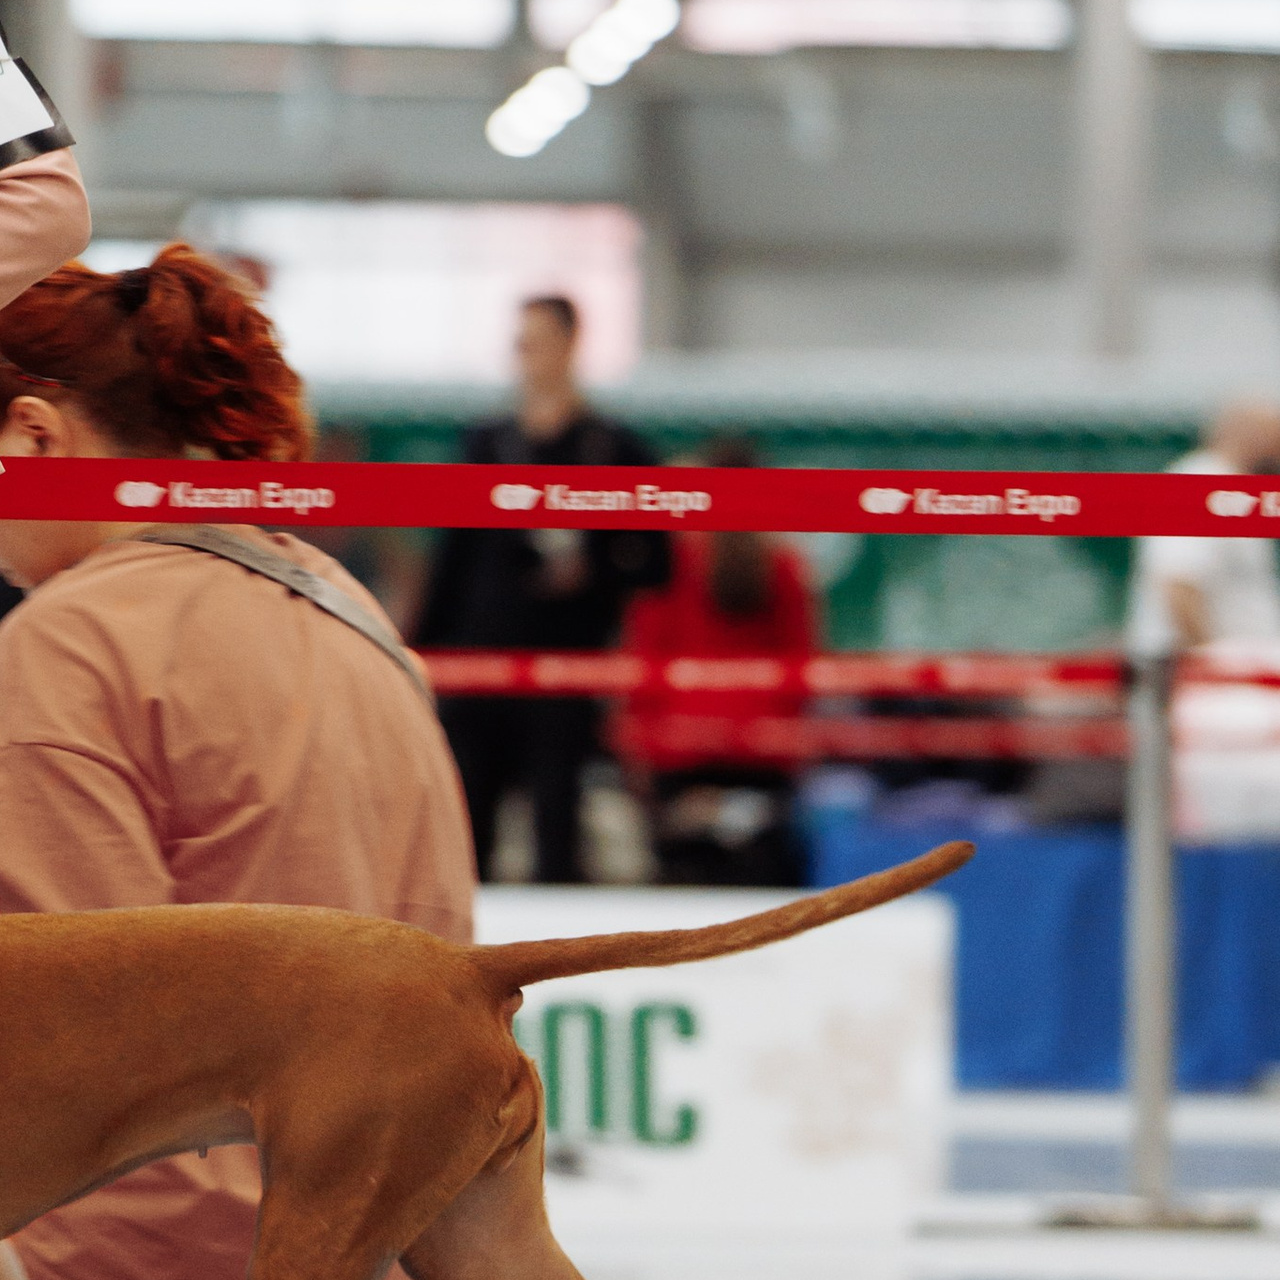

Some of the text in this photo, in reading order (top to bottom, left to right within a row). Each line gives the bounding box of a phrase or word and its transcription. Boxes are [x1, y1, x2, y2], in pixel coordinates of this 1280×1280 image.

[168, 482, 336, 516] Kazan Expo
[544, 484, 712, 518] Kazan Expo
[912, 488, 1081, 522] Kazan Expo
